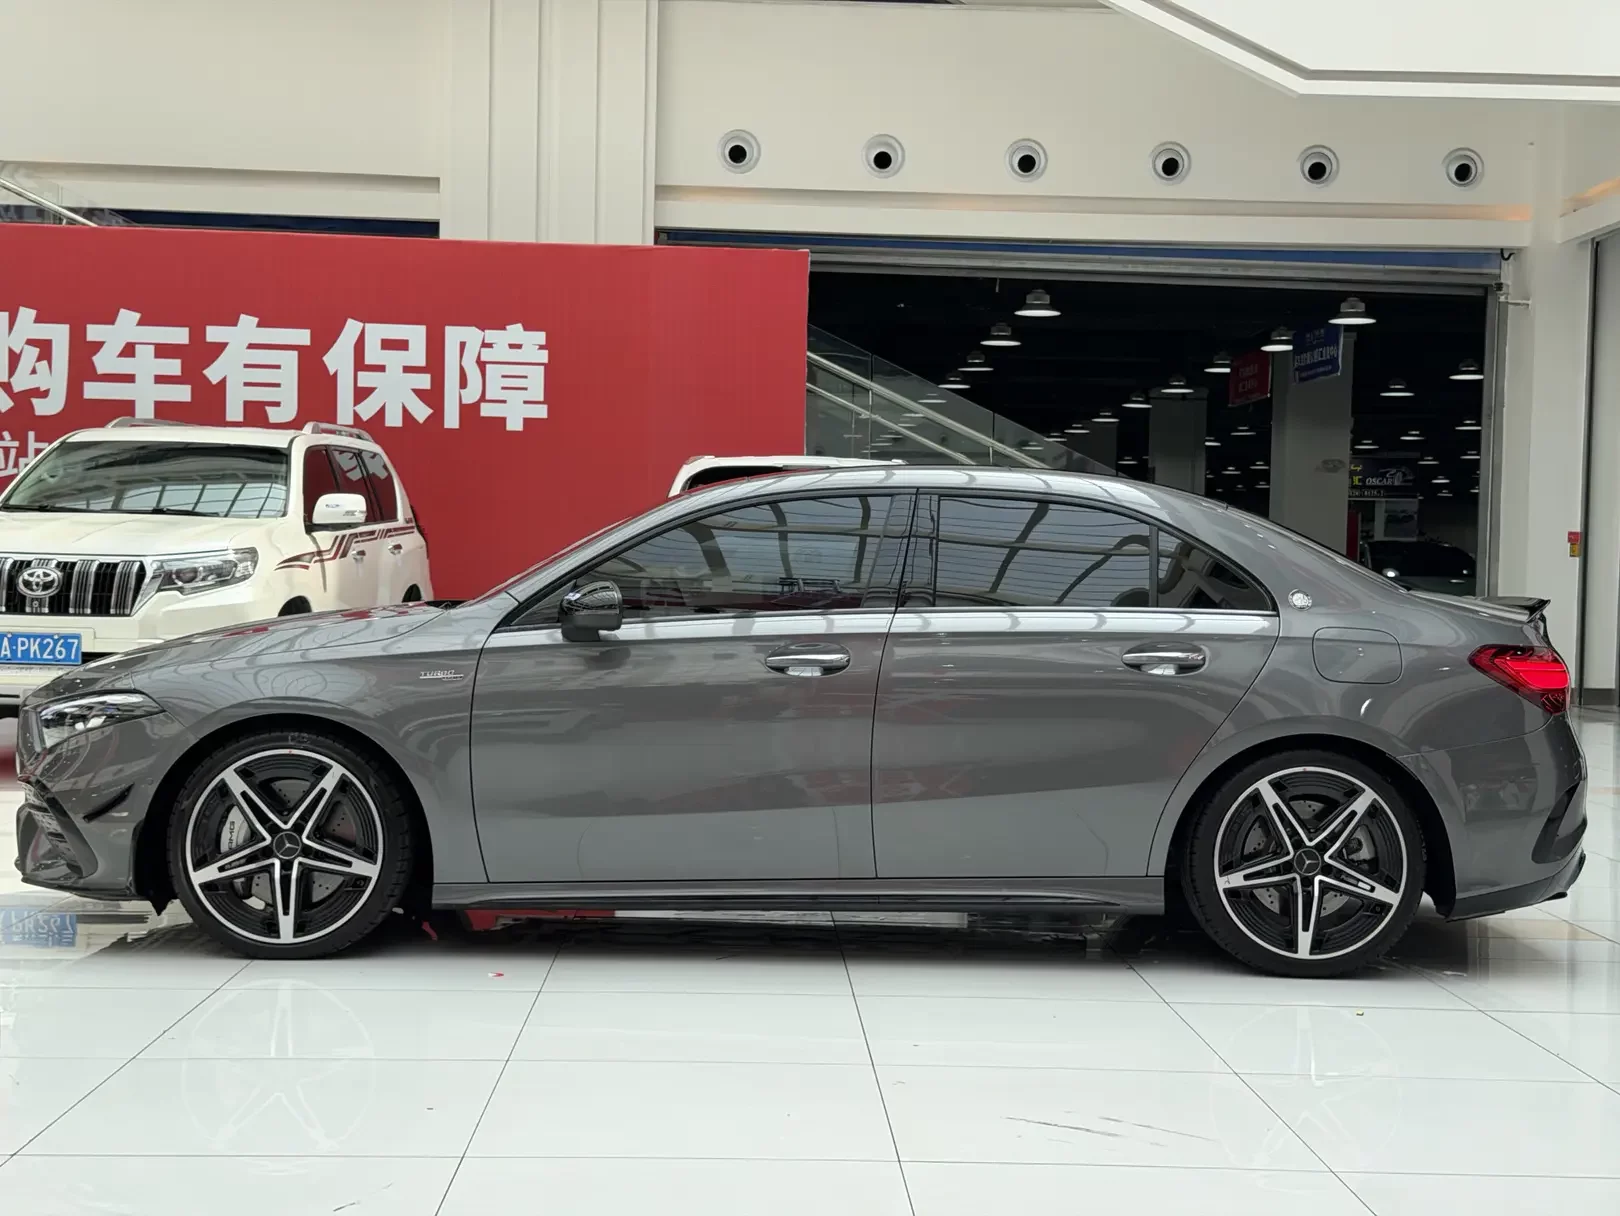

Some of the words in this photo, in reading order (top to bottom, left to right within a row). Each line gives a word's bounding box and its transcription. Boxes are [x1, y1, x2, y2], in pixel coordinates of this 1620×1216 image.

[0, 306, 549, 432] 购车有保障
[227, 820, 236, 850] AMG
